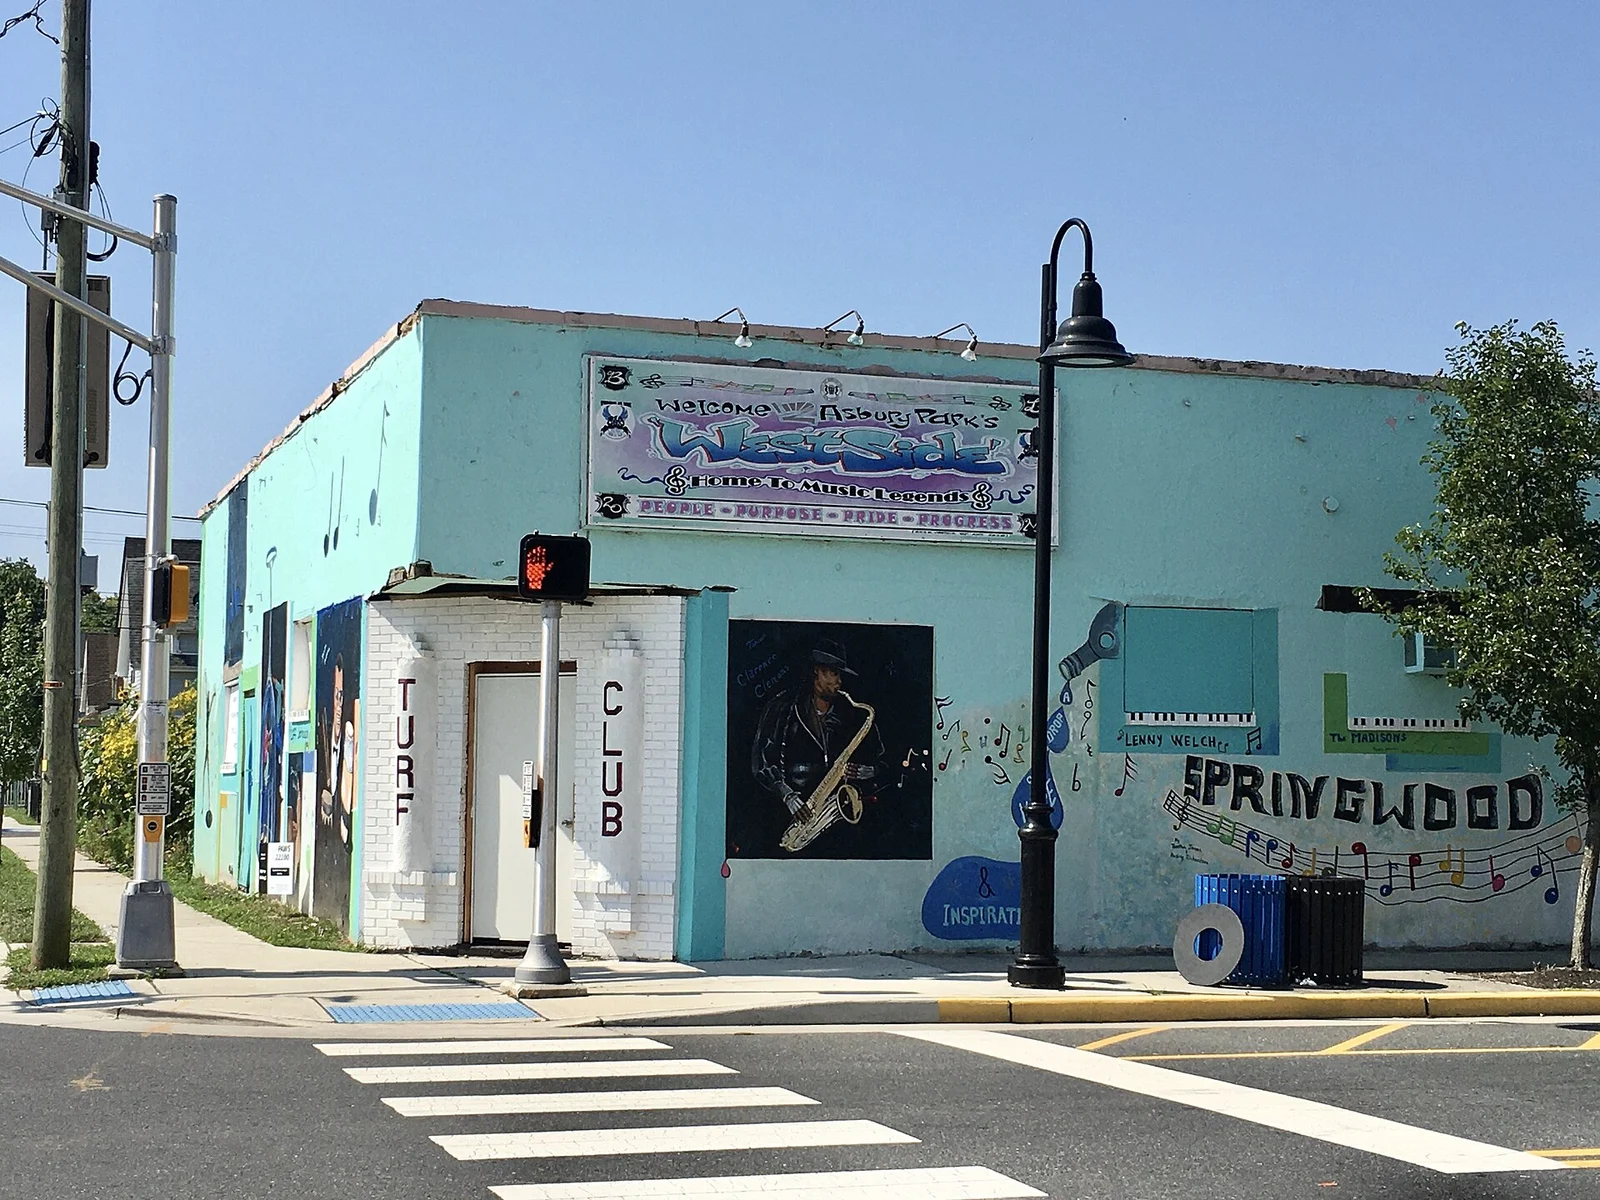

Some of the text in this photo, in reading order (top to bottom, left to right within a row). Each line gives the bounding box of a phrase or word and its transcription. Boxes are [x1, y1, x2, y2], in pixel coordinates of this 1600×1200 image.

[655, 398, 1000, 429] Welcome Asbury Park's
[691, 475, 970, 503] Home To Music Legends
[639, 499, 716, 516] PEOPLE
[735, 504, 824, 521] PURPOSE
[843, 508, 899, 525] PRIDE
[918, 512, 1013, 530] PROGRESS
[1062, 691, 1070, 703] A
[1046, 712, 1065, 744] DROP
[1124, 732, 1217, 748] LENNY WELCH
[1350, 732, 1408, 744] MADISONS
[395, 678, 417, 827] TURF
[601, 680, 624, 837] CLUB
[1183, 754, 1544, 832] SPRINGWOOD
[942, 903, 1022, 927] INSPIRATI
